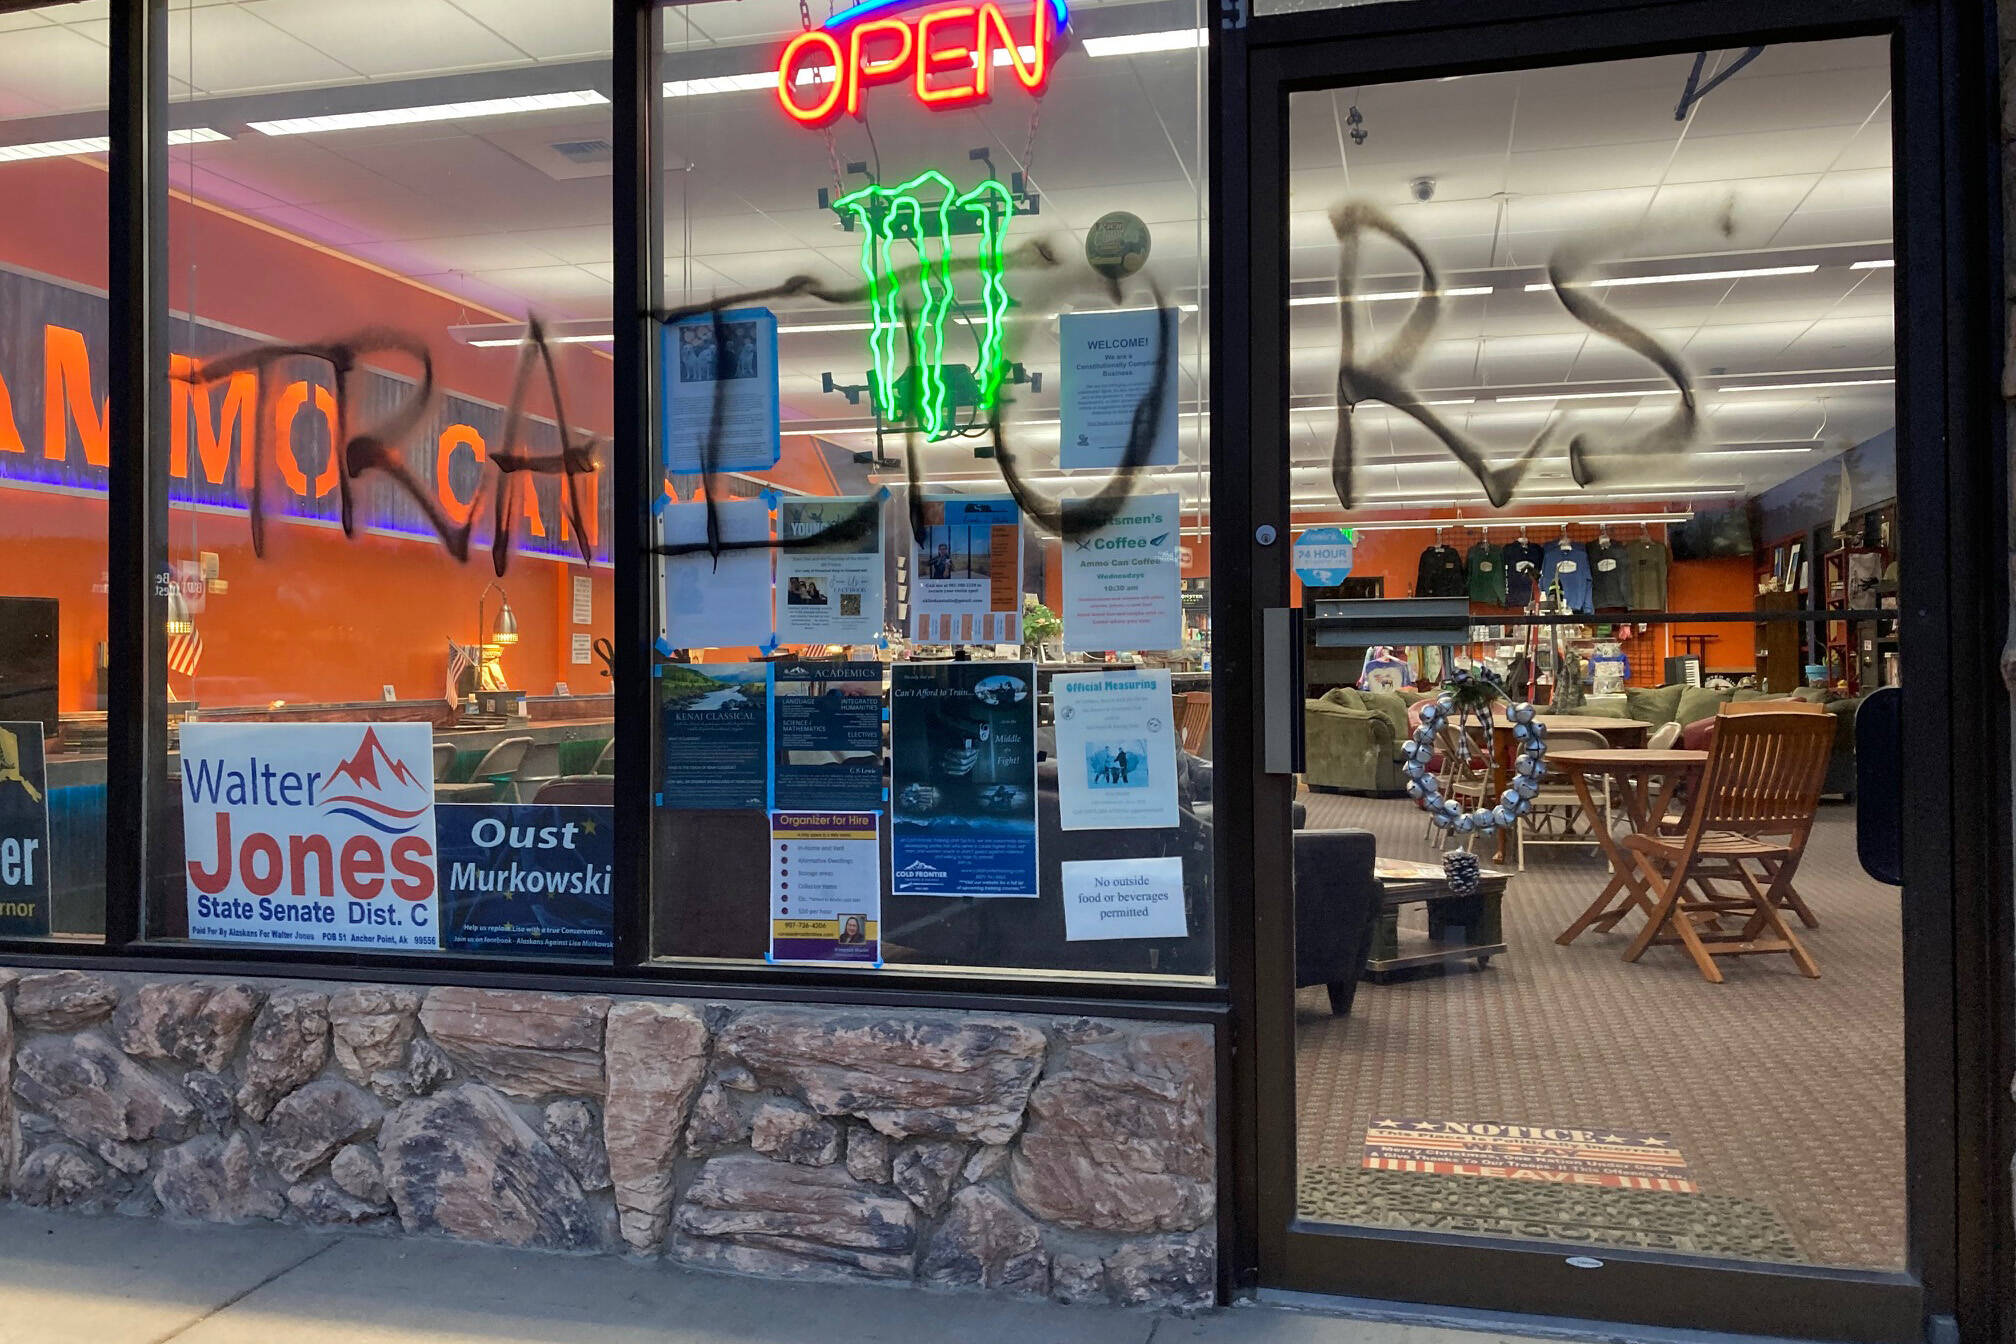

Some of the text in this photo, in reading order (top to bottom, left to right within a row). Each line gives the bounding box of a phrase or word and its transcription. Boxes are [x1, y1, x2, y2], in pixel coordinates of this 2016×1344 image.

[778, 0, 1052, 123] OPEN
[1087, 337, 1149, 350] WELCOME!
[1094, 536, 1147, 550] Coffee
[1313, 549, 1347, 559] HOUR
[1080, 557, 1161, 568] Ammo Can Coffee
[814, 669, 876, 678] ACADEMICS
[895, 688, 914, 698] Can't
[916, 687, 938, 699] Afford
[1066, 680, 1157, 693] Official Measuring
[995, 733, 1022, 744] Middle
[183, 757, 321, 806] Walter
[780, 815, 869, 827] Organizer for Hire
[472, 818, 579, 850] Oust
[187, 812, 435, 901] Jones
[450, 862, 611, 895] Murkowski
[1095, 875, 1150, 888] No outside
[1078, 891, 1169, 904] food or beverages
[197, 895, 429, 927] State Senate Dist. C
[1100, 907, 1149, 921] permitted
[192, 926, 436, 945] Paid For By Alaskans For Walter Jones POB 51 Anchor Point, Ak 99556
[464, 924, 479, 933] Help
[526, 925, 541, 933] with
[516, 937, 544, 945] Alaskans
[545, 938, 568, 946] Against
[1443, 1121, 1598, 1144] NOTICE
[1419, 1132, 1465, 1141] Place
[1493, 1137, 1578, 1150] Politically
[1586, 1145, 1672, 1155] Incorrect
[1463, 1142, 1578, 1158] WE SAY
[1382, 1146, 1668, 1173] Merry Christmas, One Nation Under God,
[1384, 1151, 1409, 1159] Give
[1414, 1154, 1459, 1164] Thanks
[1464, 1157, 1478, 1165] To
[1481, 1159, 1504, 1167] Our
[1574, 1165, 1599, 1173] This
[1603, 1167, 1654, 1177] Offends
[1453, 1163, 1602, 1185] LEAVE
